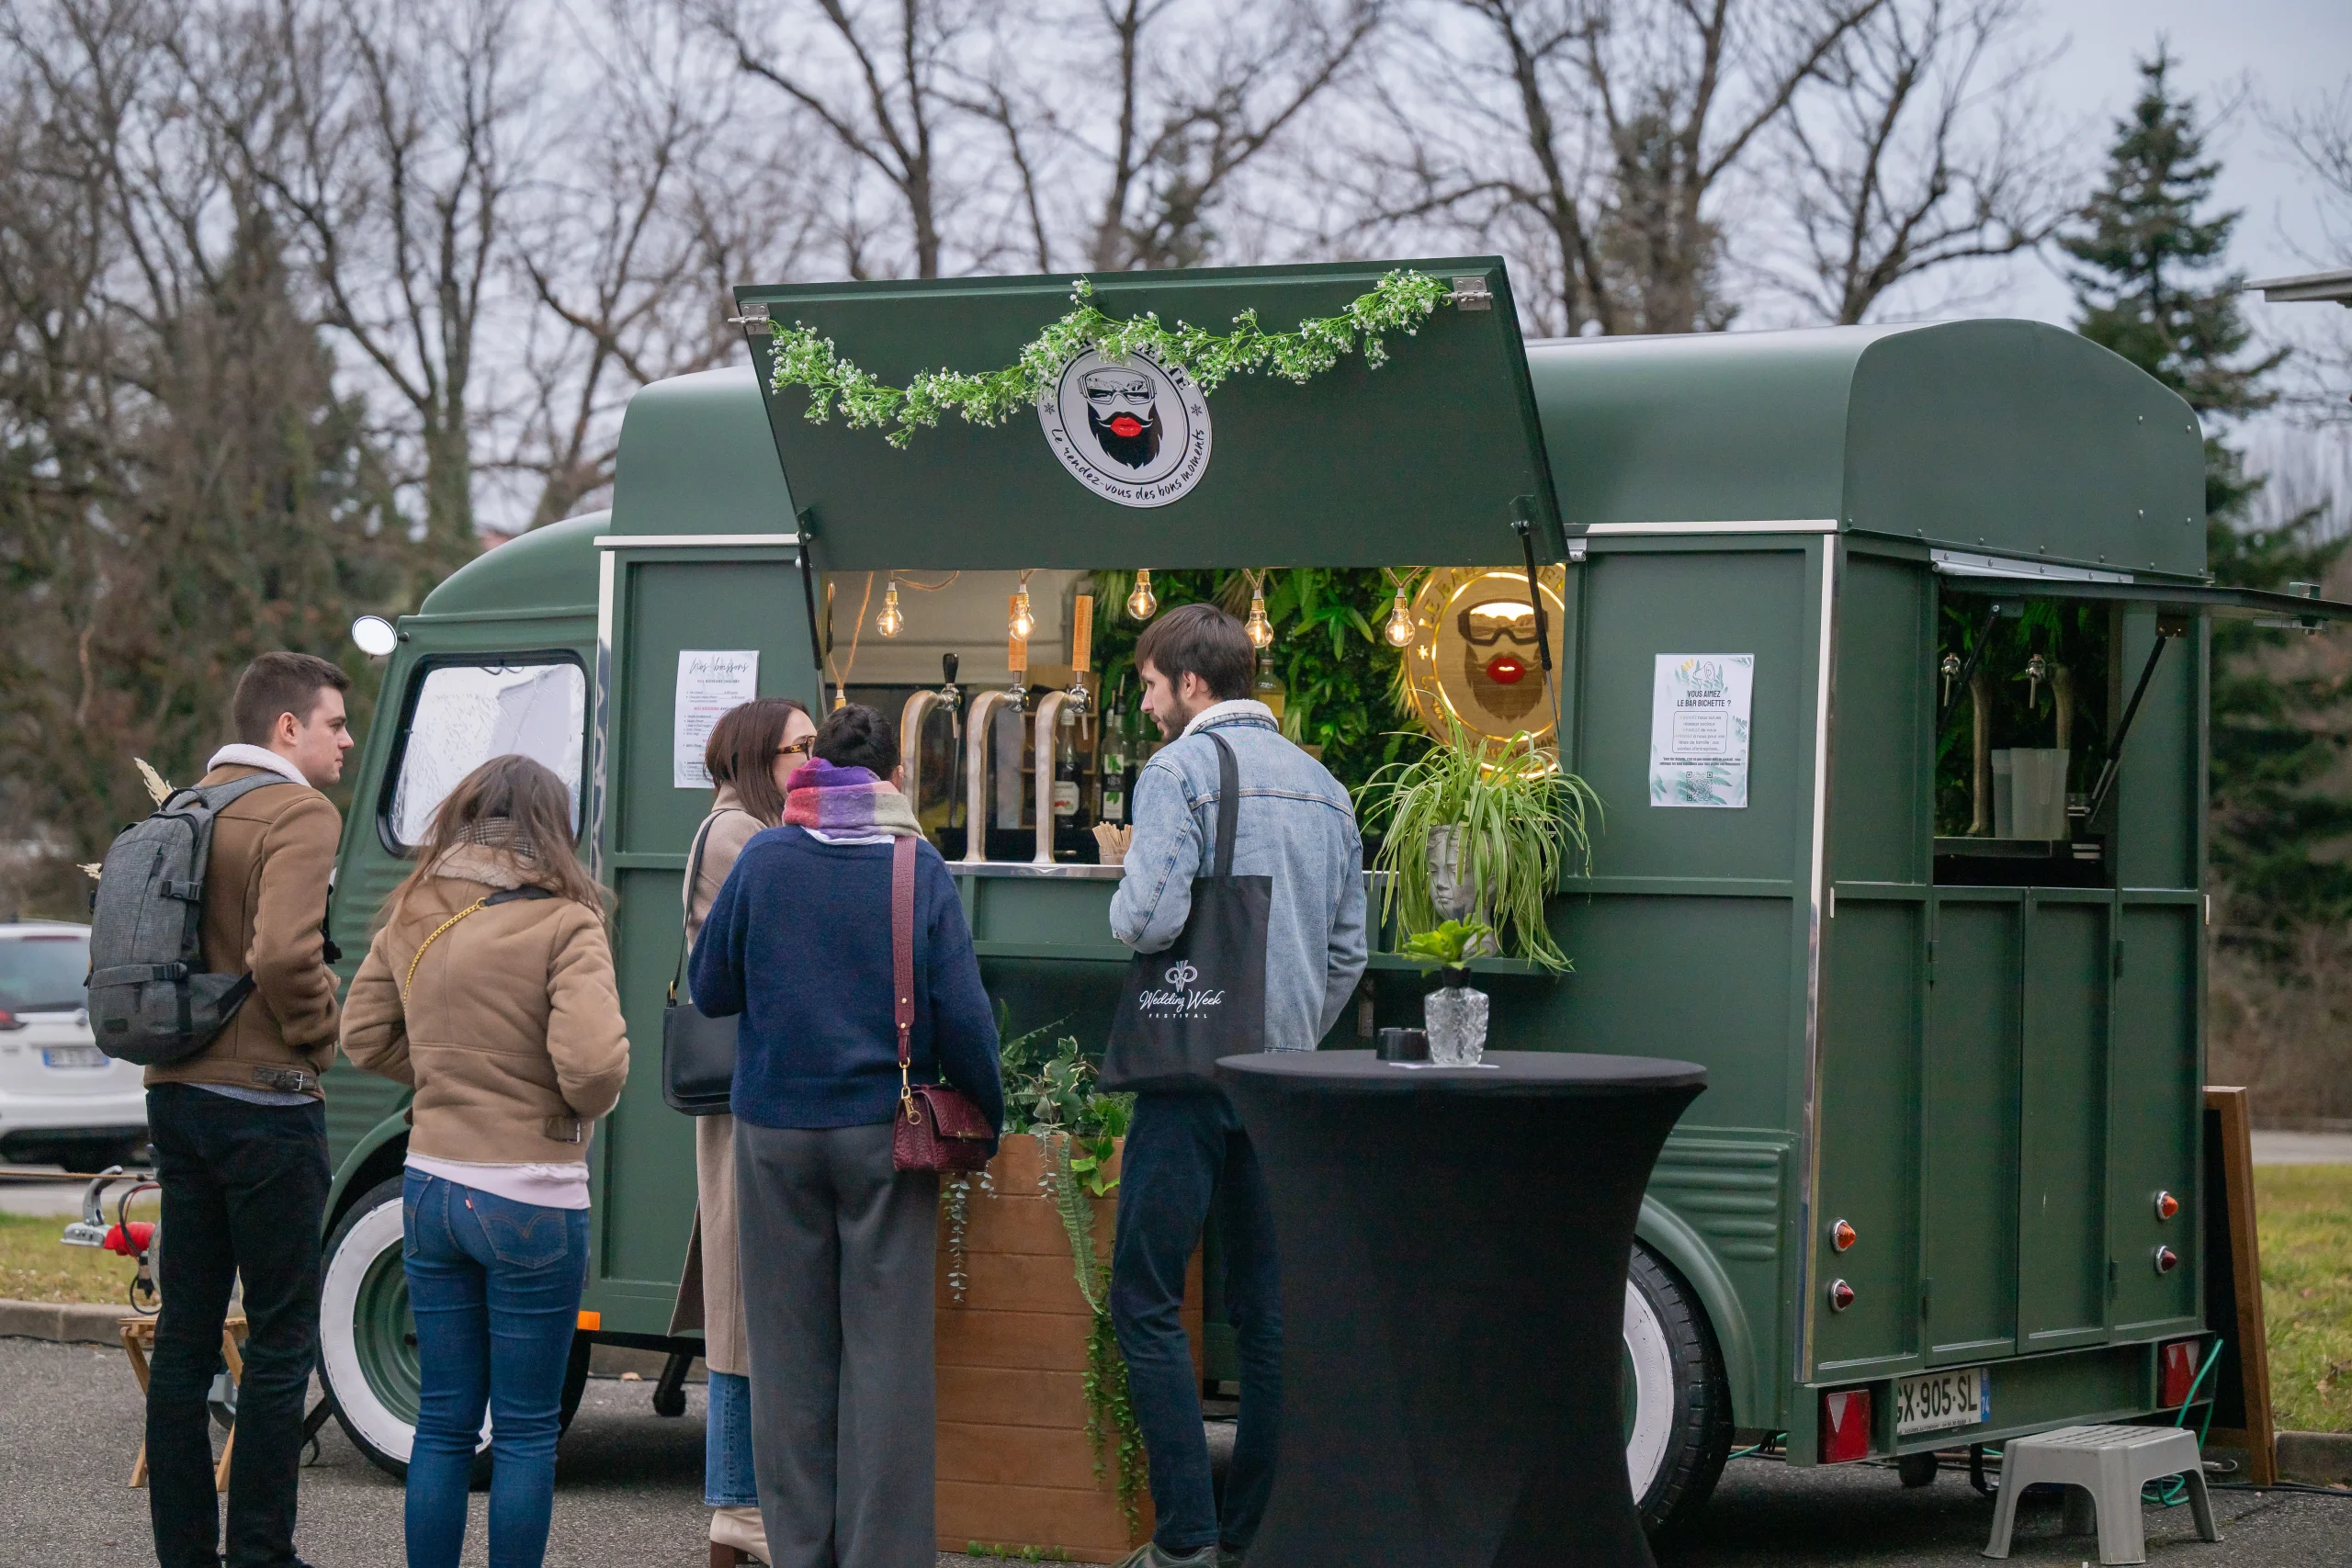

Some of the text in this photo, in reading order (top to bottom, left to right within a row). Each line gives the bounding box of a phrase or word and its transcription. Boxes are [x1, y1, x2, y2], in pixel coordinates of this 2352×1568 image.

[1051, 428, 1205, 500] Le rendez-vous des bons moments
[689, 656, 750, 674] Nos boissons
[1677, 699, 1685, 707] LE
[1685, 699, 1697, 707] BAR
[1698, 699, 1725, 707] BICHETTE
[1687, 690, 1721, 698] VOUS AIMEZ
[1139, 988, 1226, 1013] Wedding Week
[1981, 1395, 1990, 1415] 74
